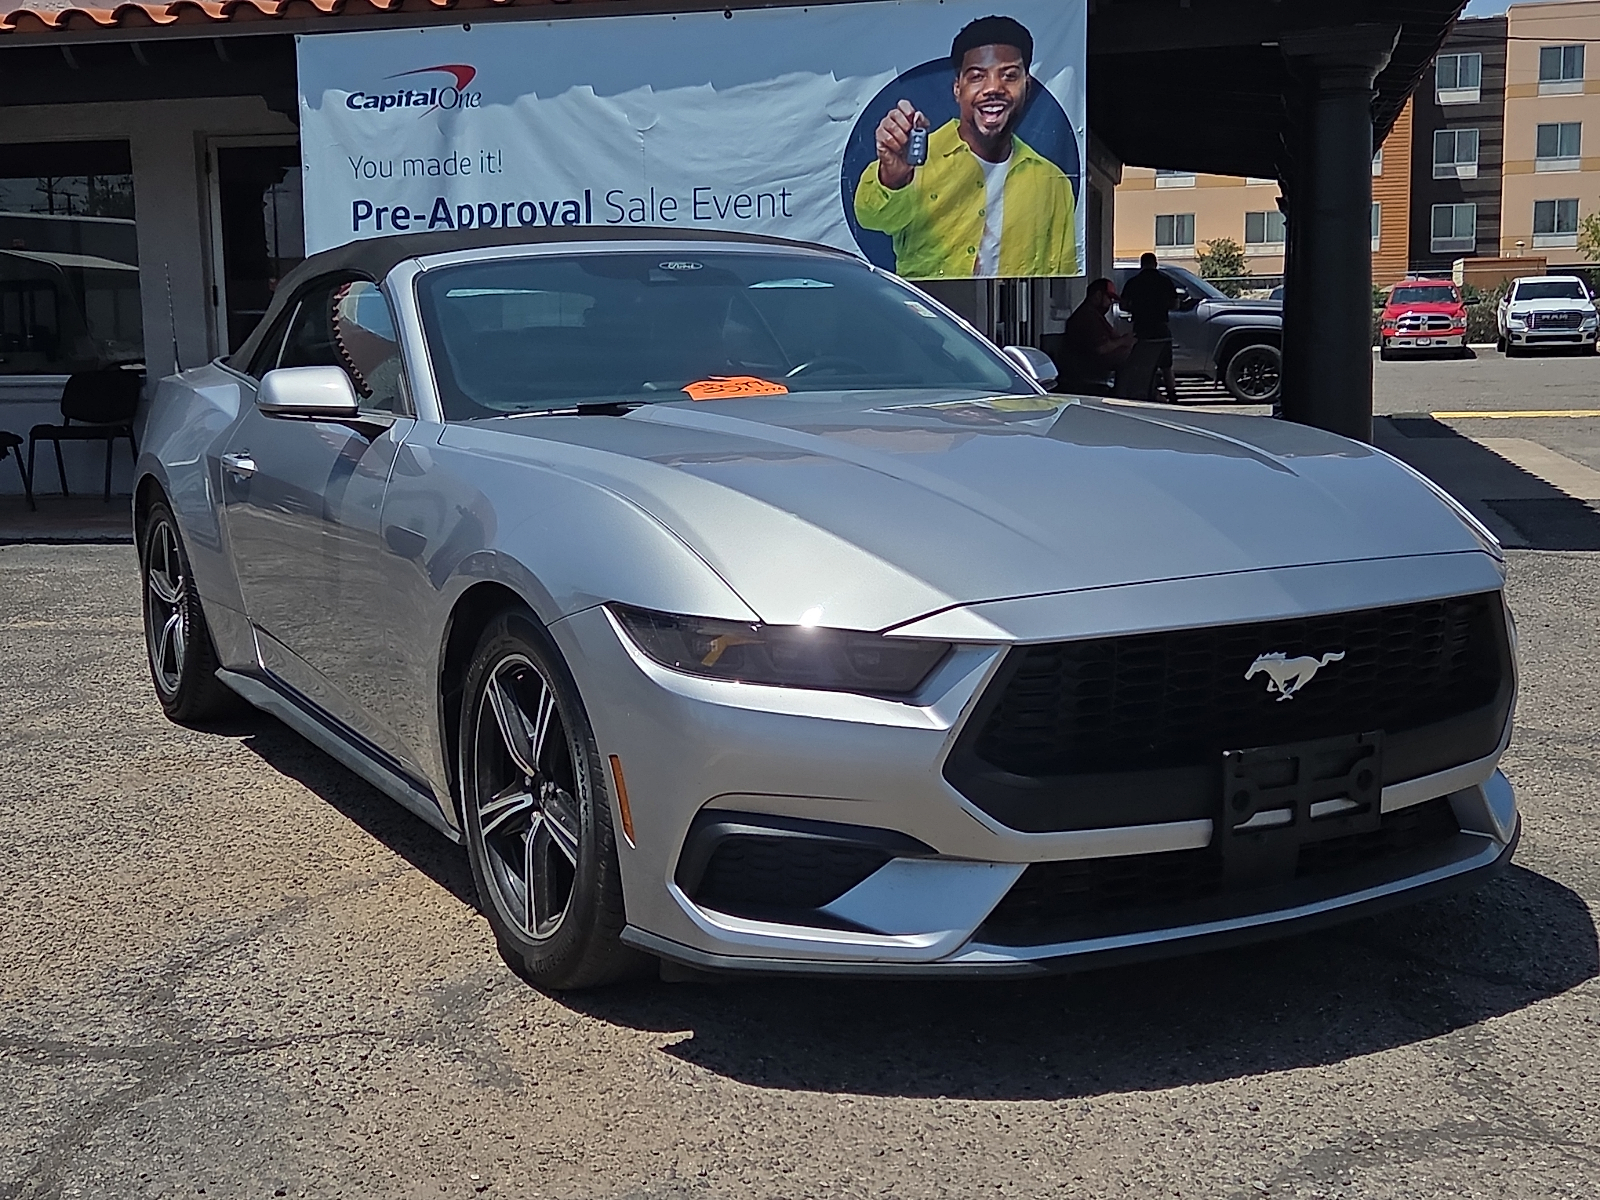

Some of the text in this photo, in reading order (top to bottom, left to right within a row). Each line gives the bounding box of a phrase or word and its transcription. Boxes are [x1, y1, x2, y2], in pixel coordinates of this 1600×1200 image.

[348, 149, 503, 180] You made it!
[352, 186, 793, 232] Pre-Approval Sale Event
